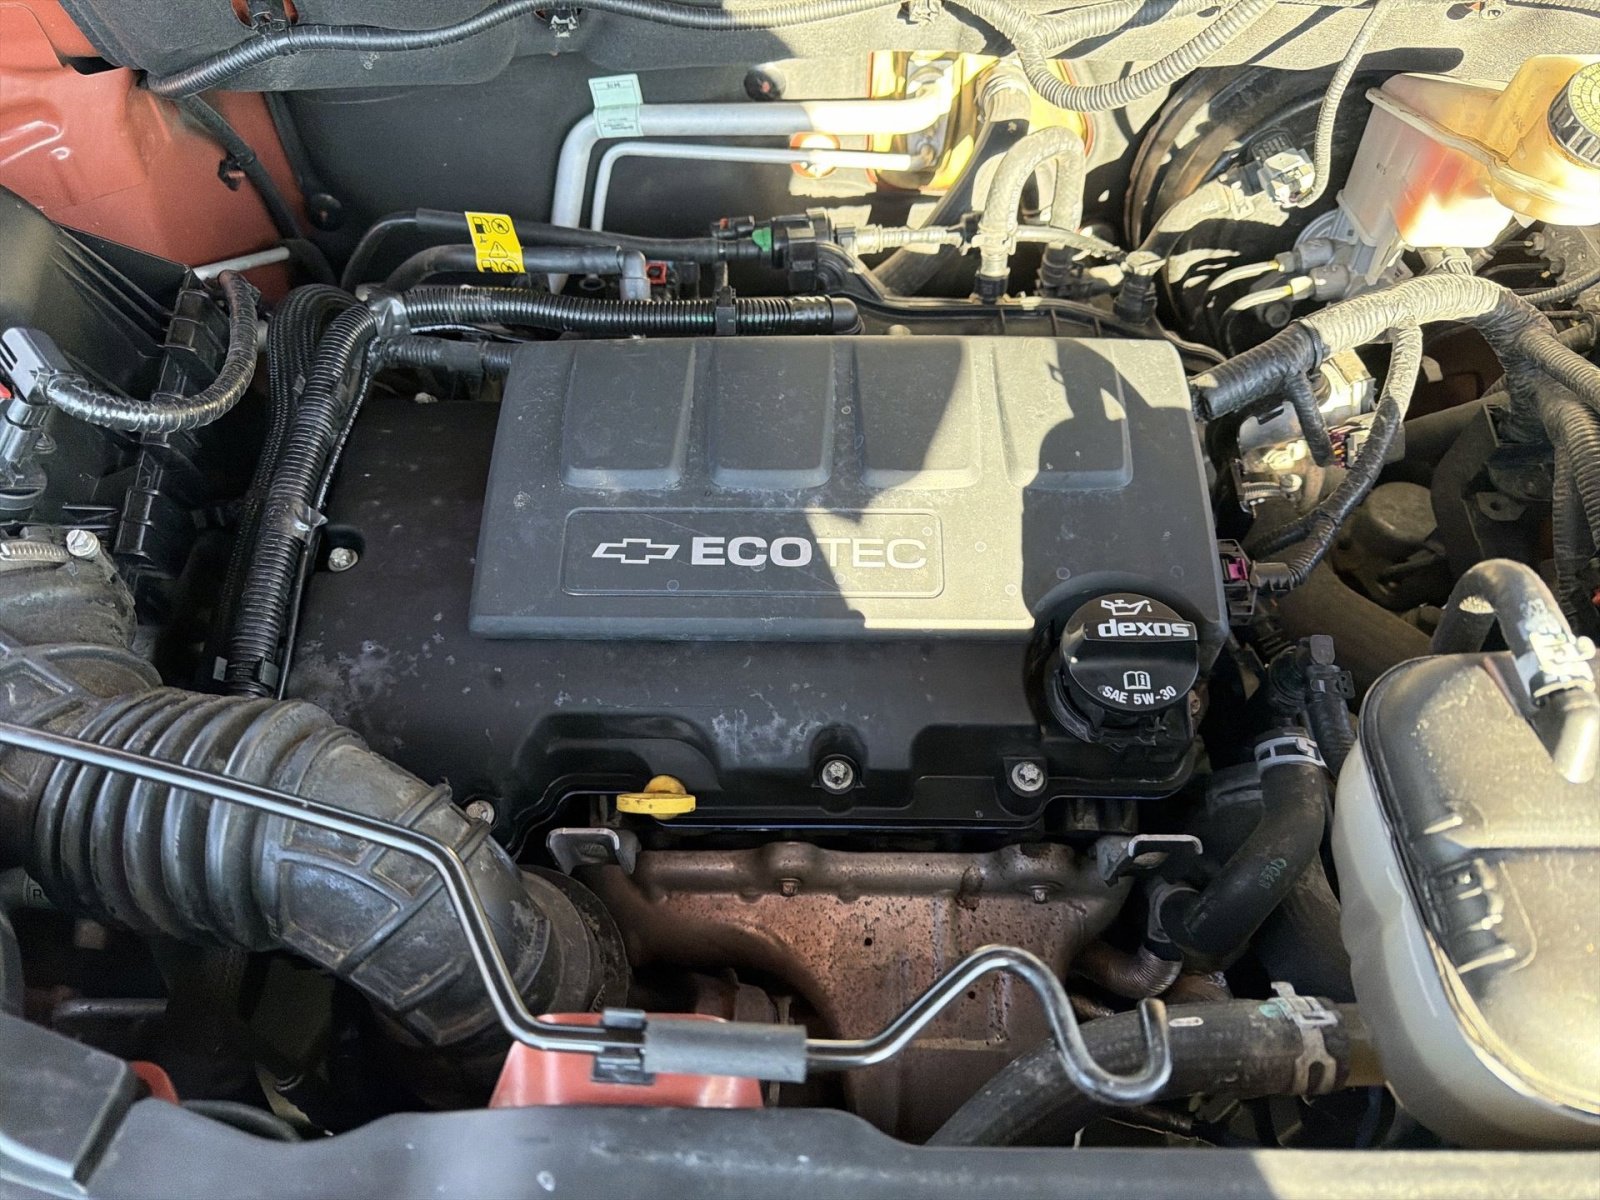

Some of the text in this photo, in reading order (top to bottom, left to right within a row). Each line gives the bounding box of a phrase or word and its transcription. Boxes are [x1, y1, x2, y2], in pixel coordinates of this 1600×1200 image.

[691, 536, 928, 569] ECOTEC
[1097, 618, 1192, 637] dexos
[1102, 685, 1177, 705] SAE 5W-30
